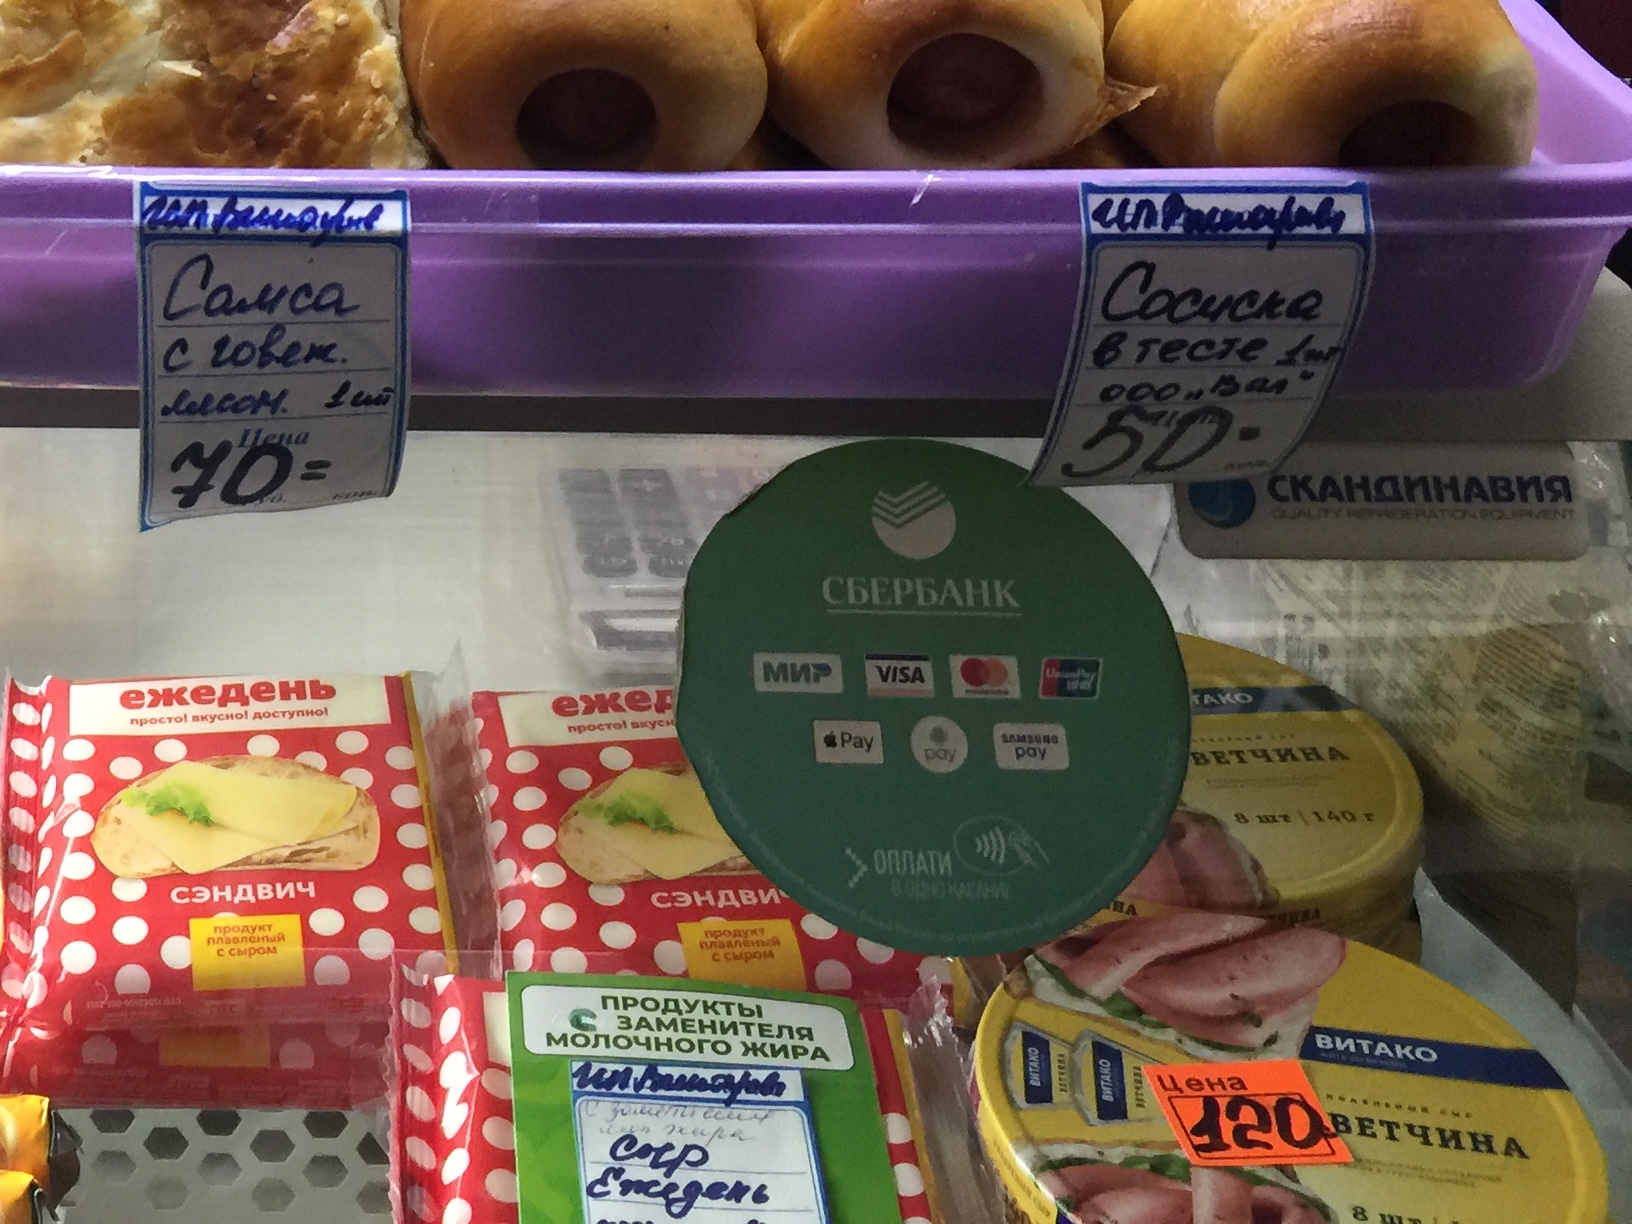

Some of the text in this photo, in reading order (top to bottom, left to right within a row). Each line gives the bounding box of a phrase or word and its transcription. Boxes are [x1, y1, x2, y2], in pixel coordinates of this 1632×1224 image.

[162, 252, 361, 322] Самса
[1100, 260, 1323, 325] Сосиска
[1268, 473, 1574, 504] СКАНДИНАВИЯ
[821, 575, 1023, 610] СБЕРБАНК
[762, 662, 833, 685] МИР
[873, 665, 926, 685] VISA
[119, 678, 337, 712] ежедень
[551, 686, 674, 718] ежед
[1190, 688, 1254, 705] ТАКО
[840, 731, 875, 753] Pay
[924, 747, 958, 763] pay
[1015, 747, 1048, 762] pay
[1191, 745, 1351, 766] ВЕТЧИНА
[873, 848, 953, 877] ОПЛАТИ
[170, 880, 316, 905] СЭНДВИЧ
[600, 994, 764, 1019] ПРОДУКТЫ
[617, 1015, 816, 1042] ЗАМЕНИТЕЛЯ
[545, 1031, 832, 1063] МОЛОЧНОГО ЖИРА
[1314, 1033, 1438, 1063] ВИТАКО
[1156, 1073, 1248, 1094] Цена
[1327, 1110, 1532, 1161] ВЕТЧИНА
